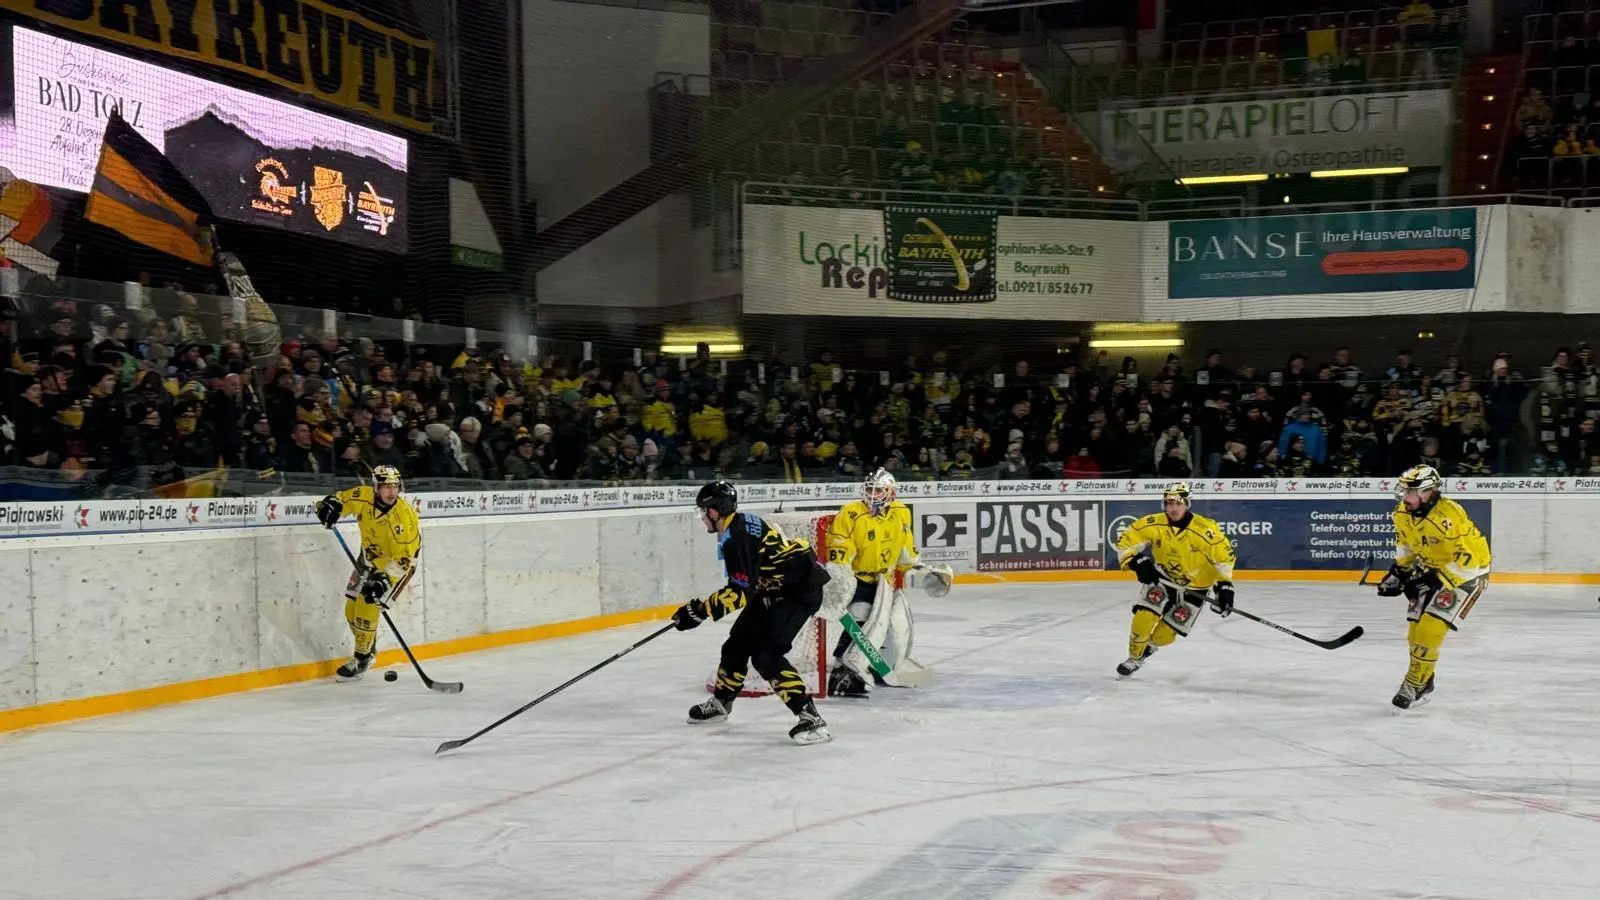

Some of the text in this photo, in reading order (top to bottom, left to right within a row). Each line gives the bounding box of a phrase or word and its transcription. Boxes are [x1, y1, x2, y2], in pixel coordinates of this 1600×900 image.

[33, 0, 430, 121] YREUTH
[38, 76, 82, 113] BAD
[1273, 144, 1405, 170] Osteopathie
[357, 200, 395, 215] BAYRUTH
[1321, 226, 1472, 243] Ihre Hausverwaltung
[898, 246, 985, 260] BAYRETH
[1173, 231, 1316, 263] BANSE
[822, 257, 889, 299] Rep
[936, 483, 975, 495] Piotrowski
[997, 481, 1053, 494] www.pio-24.de
[1075, 481, 1119, 490] Piotrowski
[1231, 480, 1278, 490] Piotrowski
[1305, 480, 1371, 491] www.pio-24.de
[1476, 479, 1545, 491] www.pio-24.de
[427, 495, 475, 513] www.pio-24.de
[492, 493, 524, 506] Piotrowski
[0, 504, 64, 523] Piotrowski
[100, 505, 178, 525] www.pio-24.de
[207, 500, 259, 517] Piotrowski
[1310, 511, 1385, 523] Generalagentur
[921, 513, 968, 548] 2F
[1216, 521, 1274, 536] ERGER
[1310, 523, 1345, 533] Telefon
[1347, 523, 1370, 533] 0921
[1310, 537, 1384, 549] Generalagentur
[828, 549, 846, 561] 67
[1310, 549, 1345, 559] Telefon
[1347, 549, 1370, 559] 0921
[1453, 551, 1473, 567] 77
[853, 631, 883, 665] AGROBS
